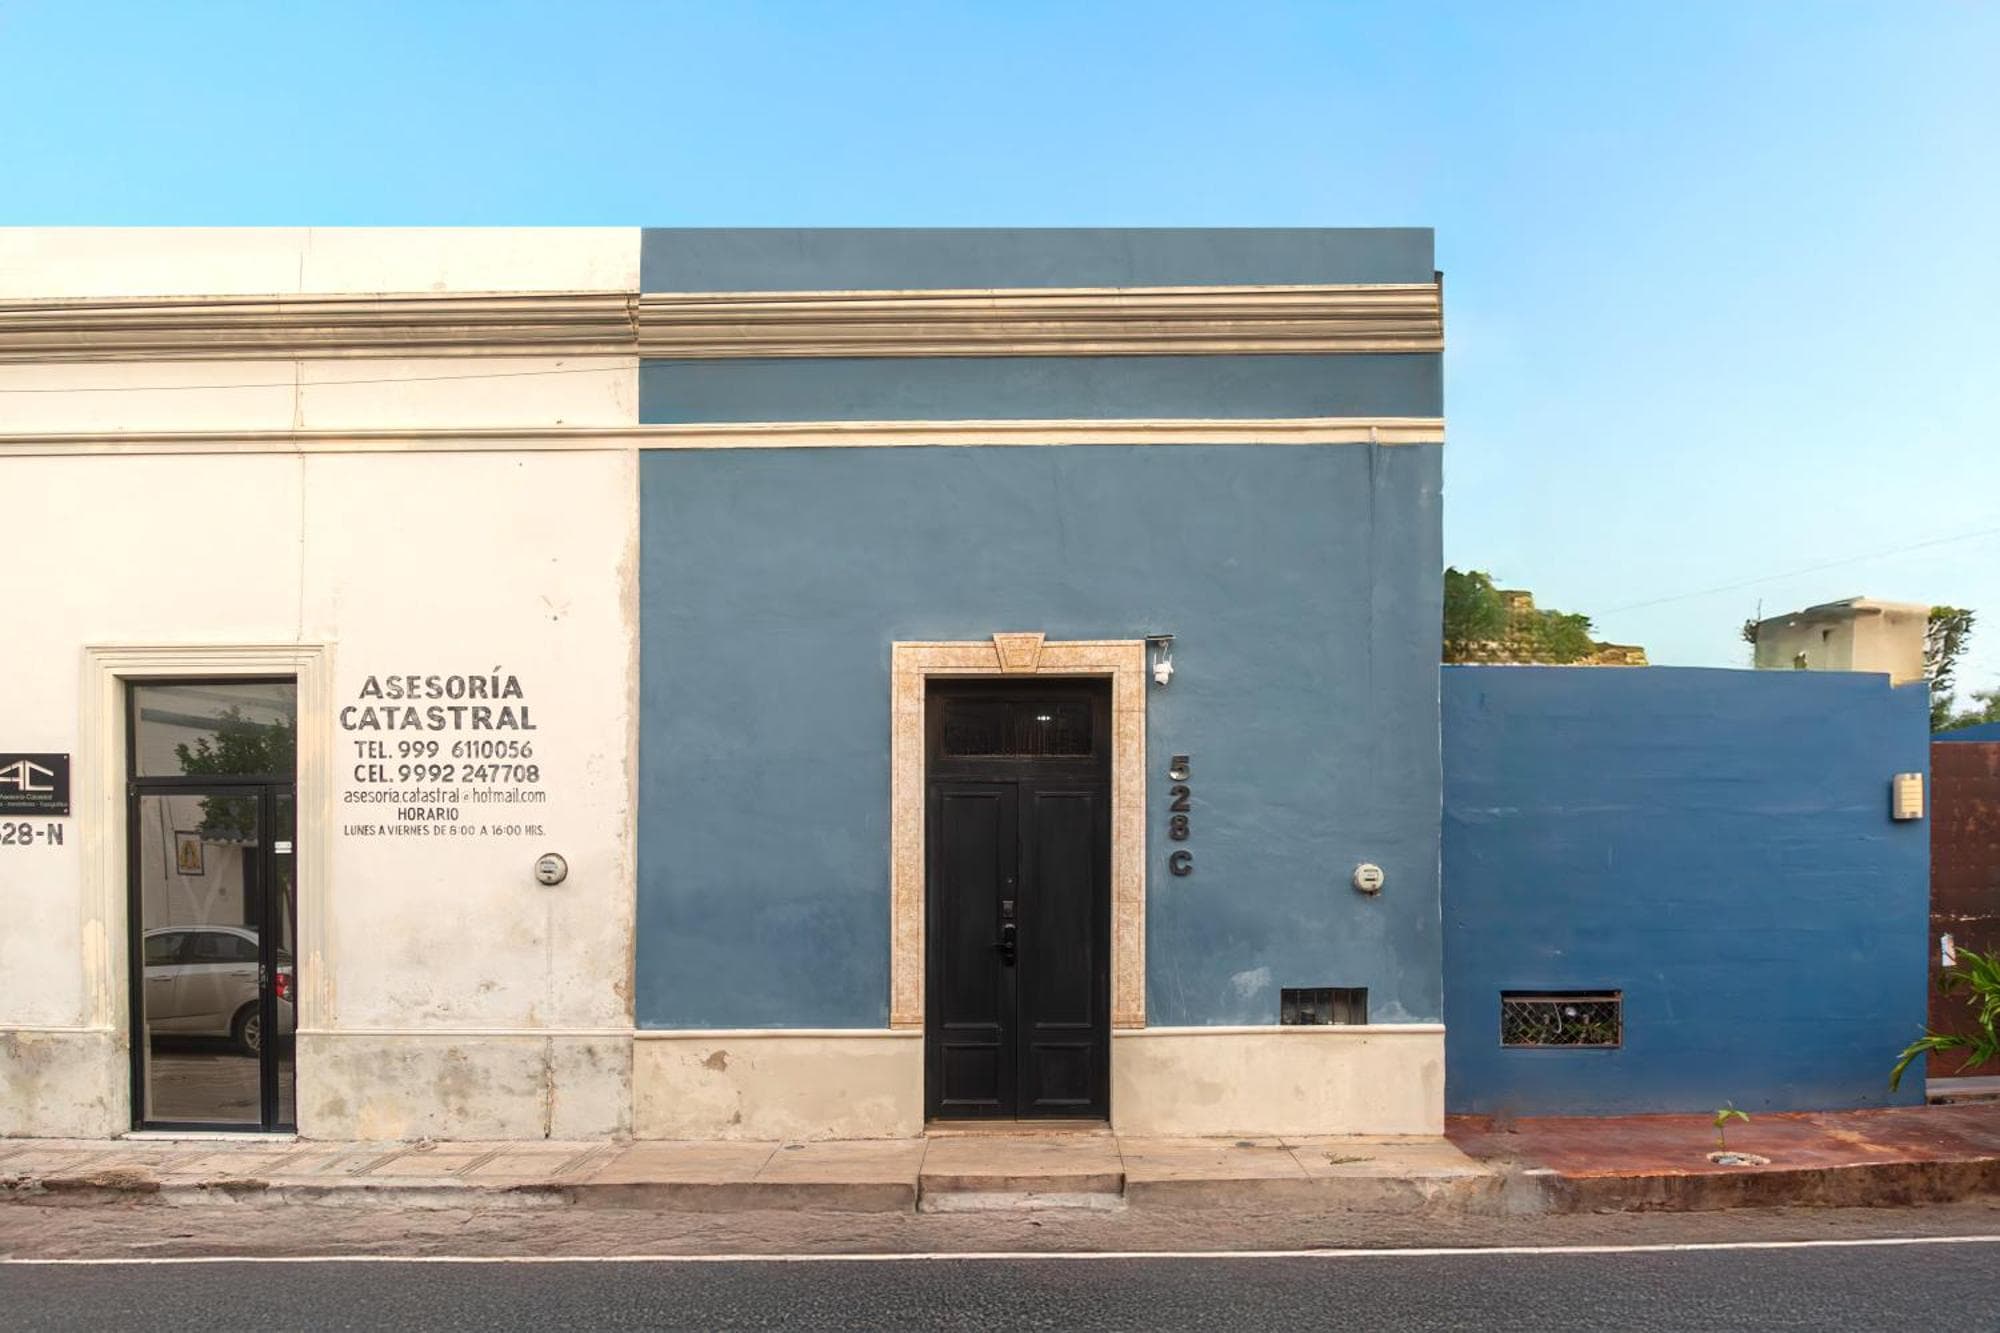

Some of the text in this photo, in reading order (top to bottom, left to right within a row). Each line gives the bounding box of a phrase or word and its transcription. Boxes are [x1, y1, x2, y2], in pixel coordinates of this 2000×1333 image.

[359, 665, 524, 700] ASESORÍA
[339, 705, 537, 731] CATASTRAL
[354, 740, 533, 759] TEL. 999 6110056
[354, 764, 540, 783] CEL. 9992 247708
[398, 807, 459, 821] HORARIO
[0, 822, 63, 846] 28-N
[344, 825, 376, 836] LUNES
[378, 825, 386, 836] A
[387, 825, 430, 836] VIERNES
[433, 825, 448, 836] DE
[480, 825, 489, 836] A
[492, 825, 522, 836] 16:00
